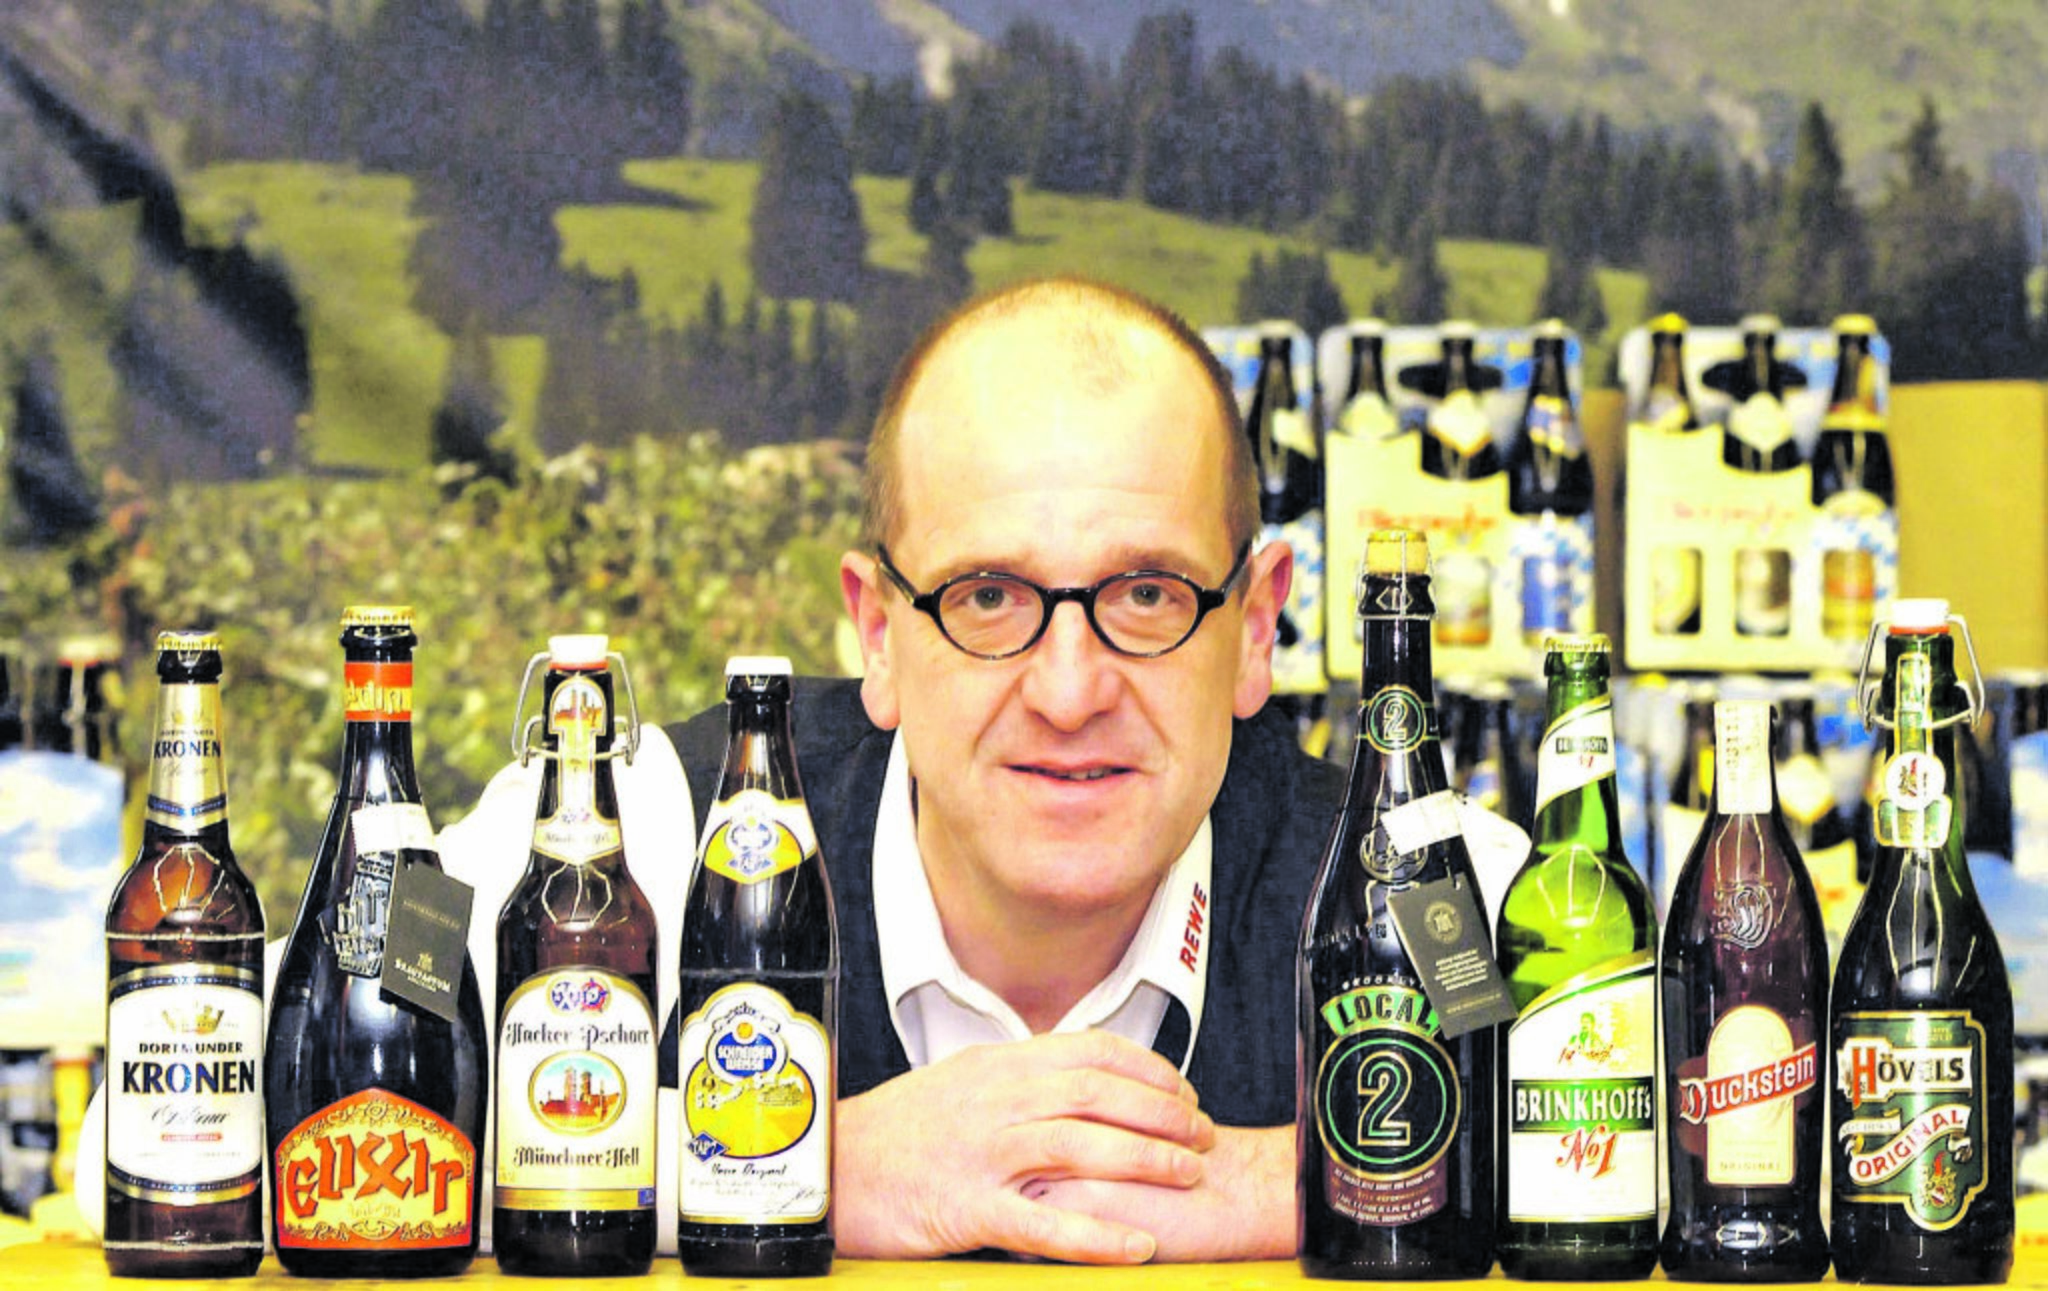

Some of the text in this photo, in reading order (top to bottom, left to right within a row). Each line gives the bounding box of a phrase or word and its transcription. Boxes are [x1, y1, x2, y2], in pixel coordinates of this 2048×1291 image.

[1383, 700, 1407, 741] 2
[153, 740, 221, 759] KRONEN
[1179, 882, 1207, 974] REWE
[1335, 993, 1434, 1030] LOCAL
[122, 1059, 255, 1094] KRONEN
[1357, 1049, 1412, 1147] 2
[1679, 1053, 1814, 1126] Duckstein
[1856, 1109, 1964, 1179] ORIGINAL
